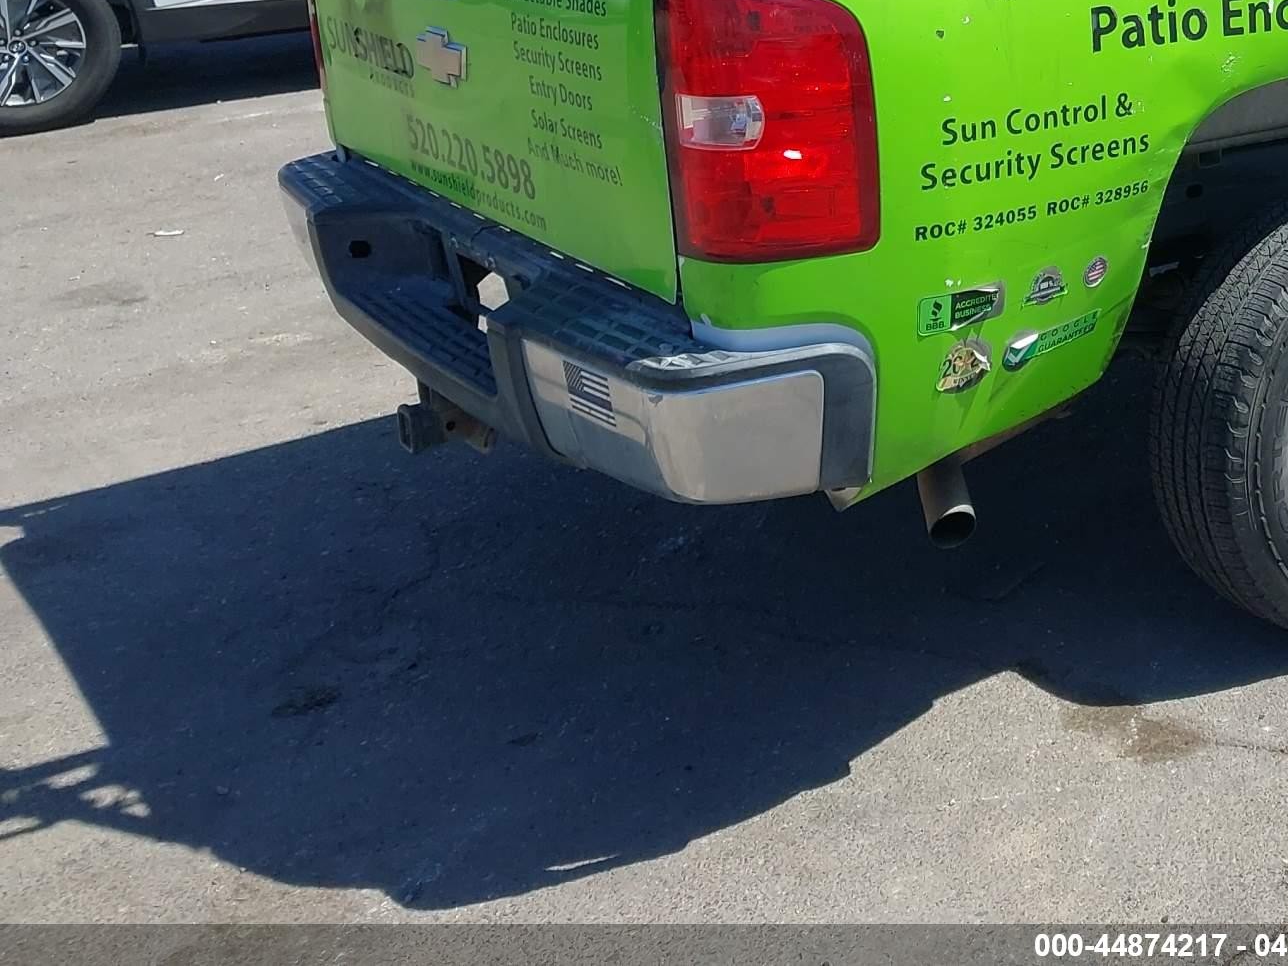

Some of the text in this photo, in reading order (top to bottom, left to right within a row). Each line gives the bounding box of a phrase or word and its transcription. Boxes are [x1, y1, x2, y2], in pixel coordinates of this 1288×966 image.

[327, 16, 414, 79] SUNSHIELD
[511, 12, 599, 50] Patio Enclosures
[513, 41, 602, 81] Security Screens
[529, 75, 593, 111] Entry Doors
[531, 108, 602, 149] Solar Screens
[941, 92, 1133, 146] Sun Control &
[406, 114, 536, 200] 520.220.5898
[528, 137, 623, 187] And Much more!
[921, 134, 1150, 191] Security Screens
[410, 161, 547, 231] www.sunshieldproducts.com
[915, 180, 1149, 242] ROC# 324055 ROC# 328956
[955, 294, 997, 310] ACCREDITE
[926, 320, 945, 331] BBB
[1040, 310, 1099, 341] GOOGLE
